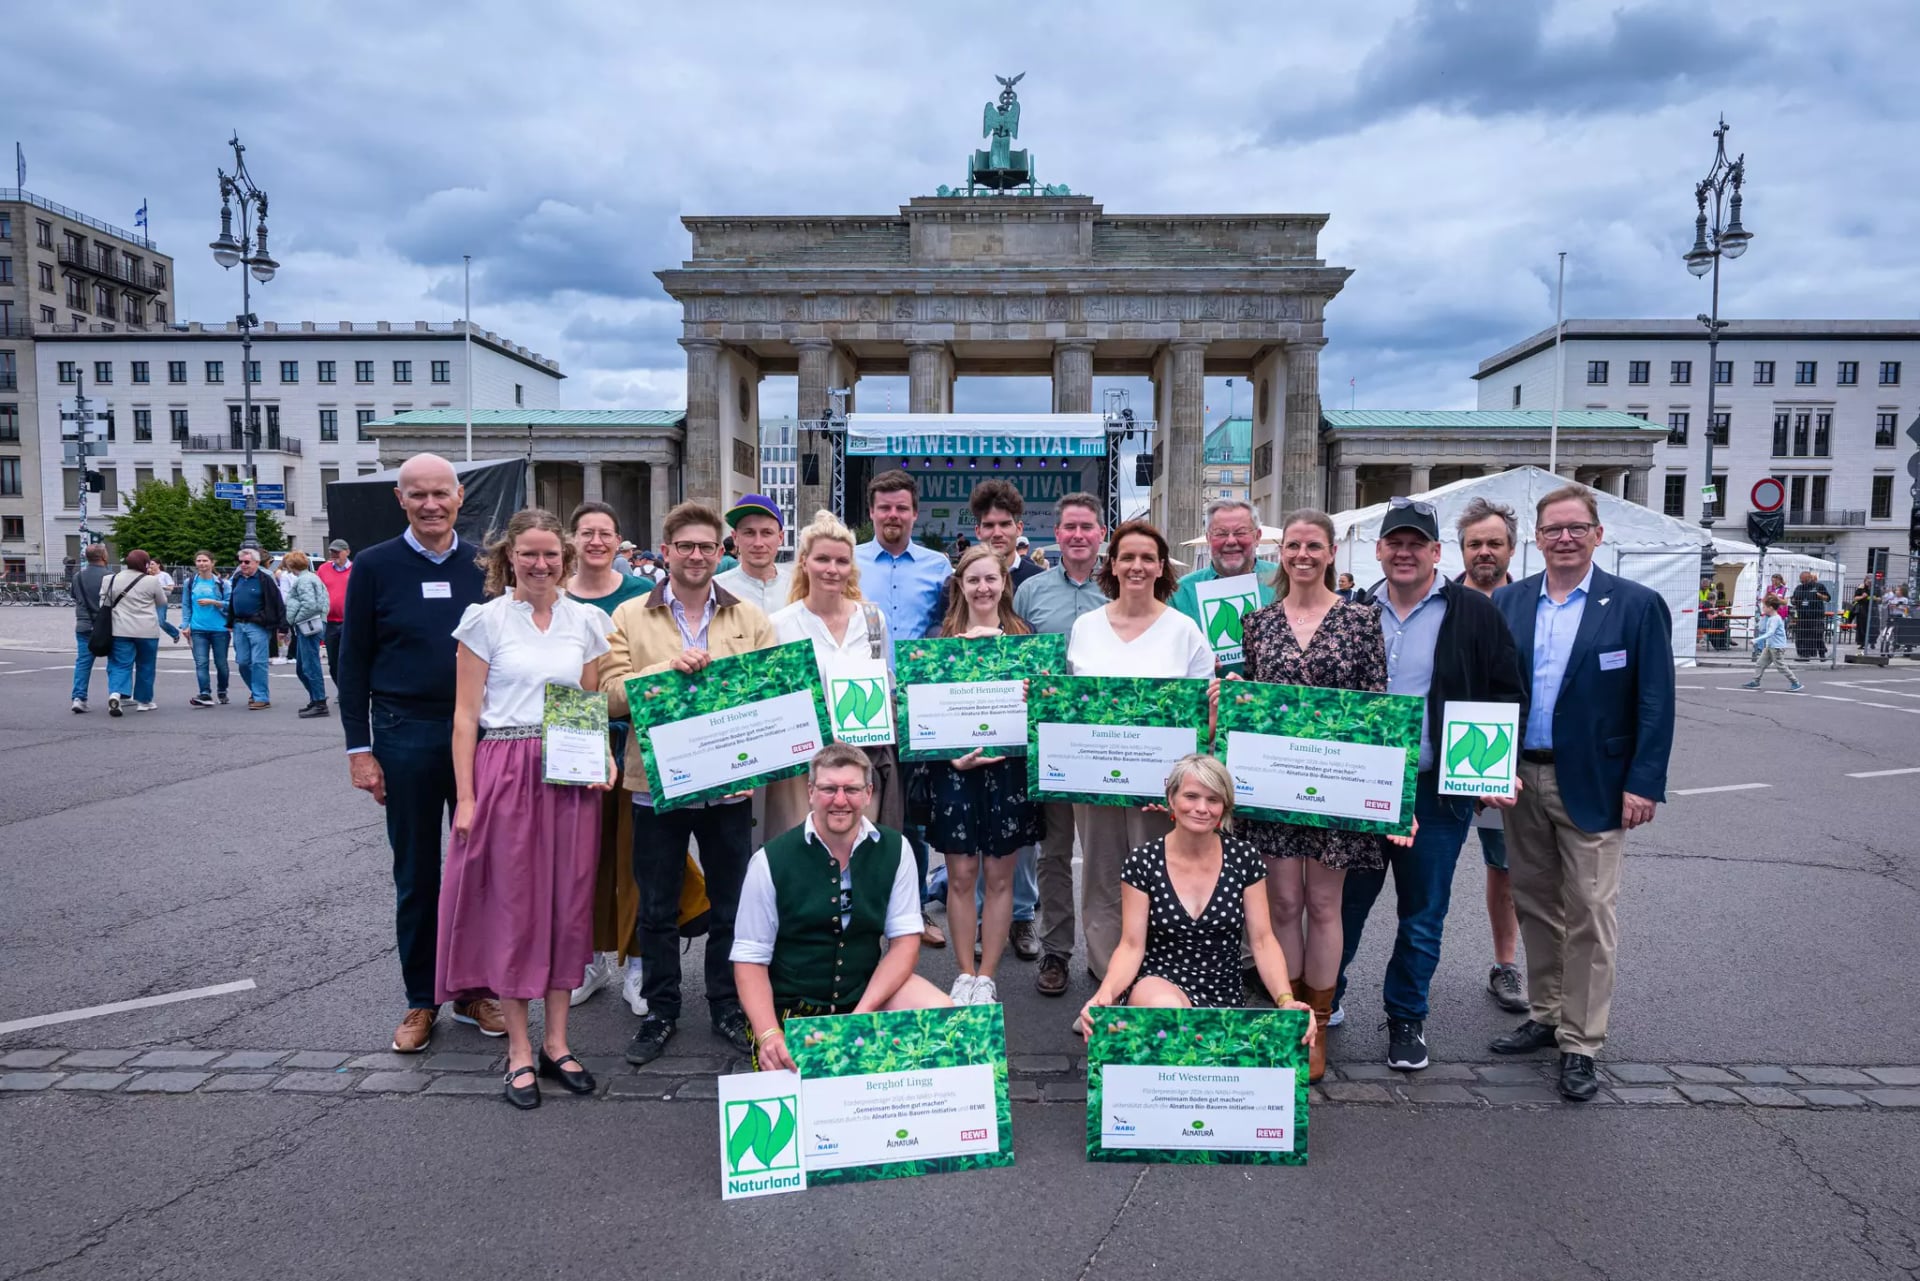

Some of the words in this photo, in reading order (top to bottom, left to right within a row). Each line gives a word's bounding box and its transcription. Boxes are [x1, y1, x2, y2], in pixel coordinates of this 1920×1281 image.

[892, 435, 1075, 454] UMWELTFESTIVAL
[950, 687, 974, 695] Biohof
[976, 686, 1016, 695] Henninger
[710, 716, 724, 726] Hof
[727, 709, 758, 723] Holweg
[838, 732, 890, 744] Naturland
[1092, 730, 1121, 739] Familie
[792, 741, 814, 753] REWE
[1289, 743, 1321, 753] Familie
[1324, 745, 1341, 755] Jost
[1444, 780, 1509, 793] Naturland
[1366, 800, 1390, 810] REWE
[1158, 1072, 1175, 1081] Hof
[1179, 1073, 1240, 1082] Westermann
[866, 1078, 904, 1091] Berghof
[907, 1077, 933, 1087] Lingg
[961, 1129, 986, 1140] REWE
[1182, 1128, 1214, 1137] ALNATURA
[728, 1173, 800, 1194] Naturland
